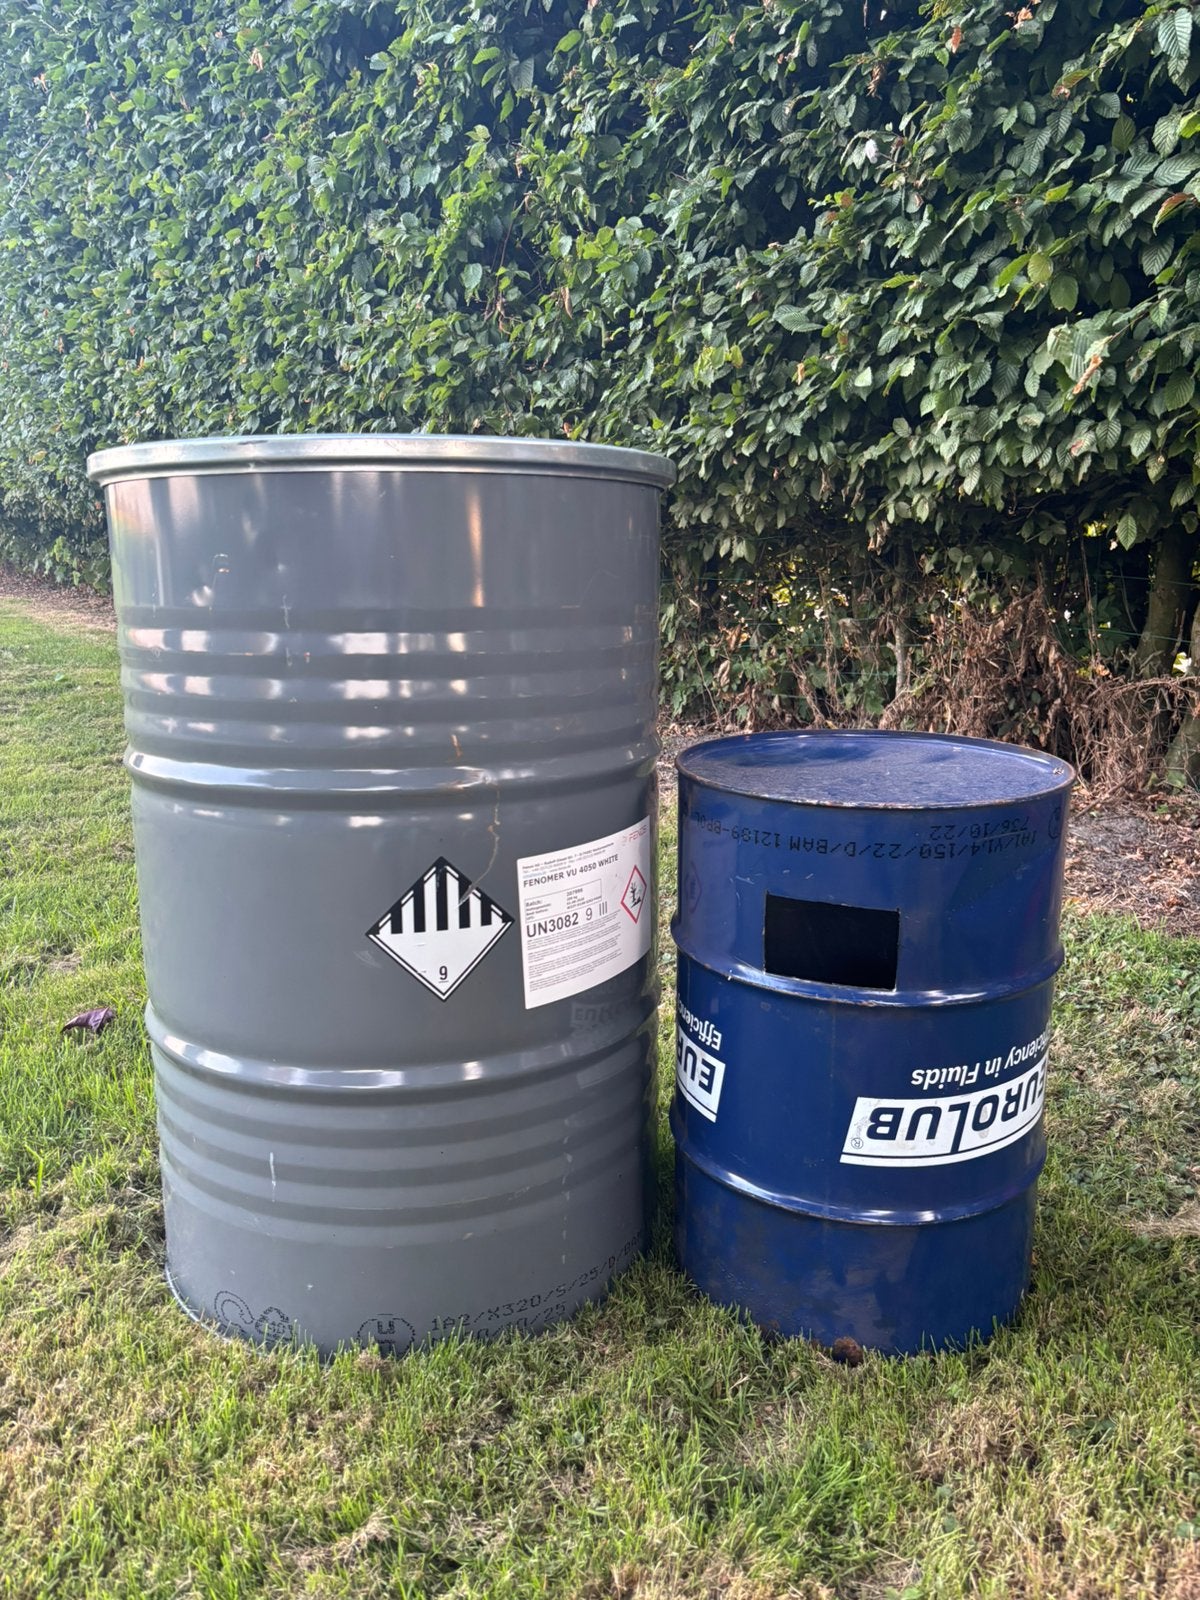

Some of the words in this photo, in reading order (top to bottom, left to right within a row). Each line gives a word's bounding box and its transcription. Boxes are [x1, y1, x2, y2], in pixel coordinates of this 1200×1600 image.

[523, 871, 565, 888] FENOMER
[566, 868, 578, 878] VU
[579, 862, 597, 873] 4050
[598, 853, 619, 867] WHITE
[526, 912, 579, 938] UN3082
[585, 907, 593, 921] 9
[439, 965, 448, 980] 9
[910, 1062, 980, 1090] Fluids
[985, 1056, 1003, 1078] in
